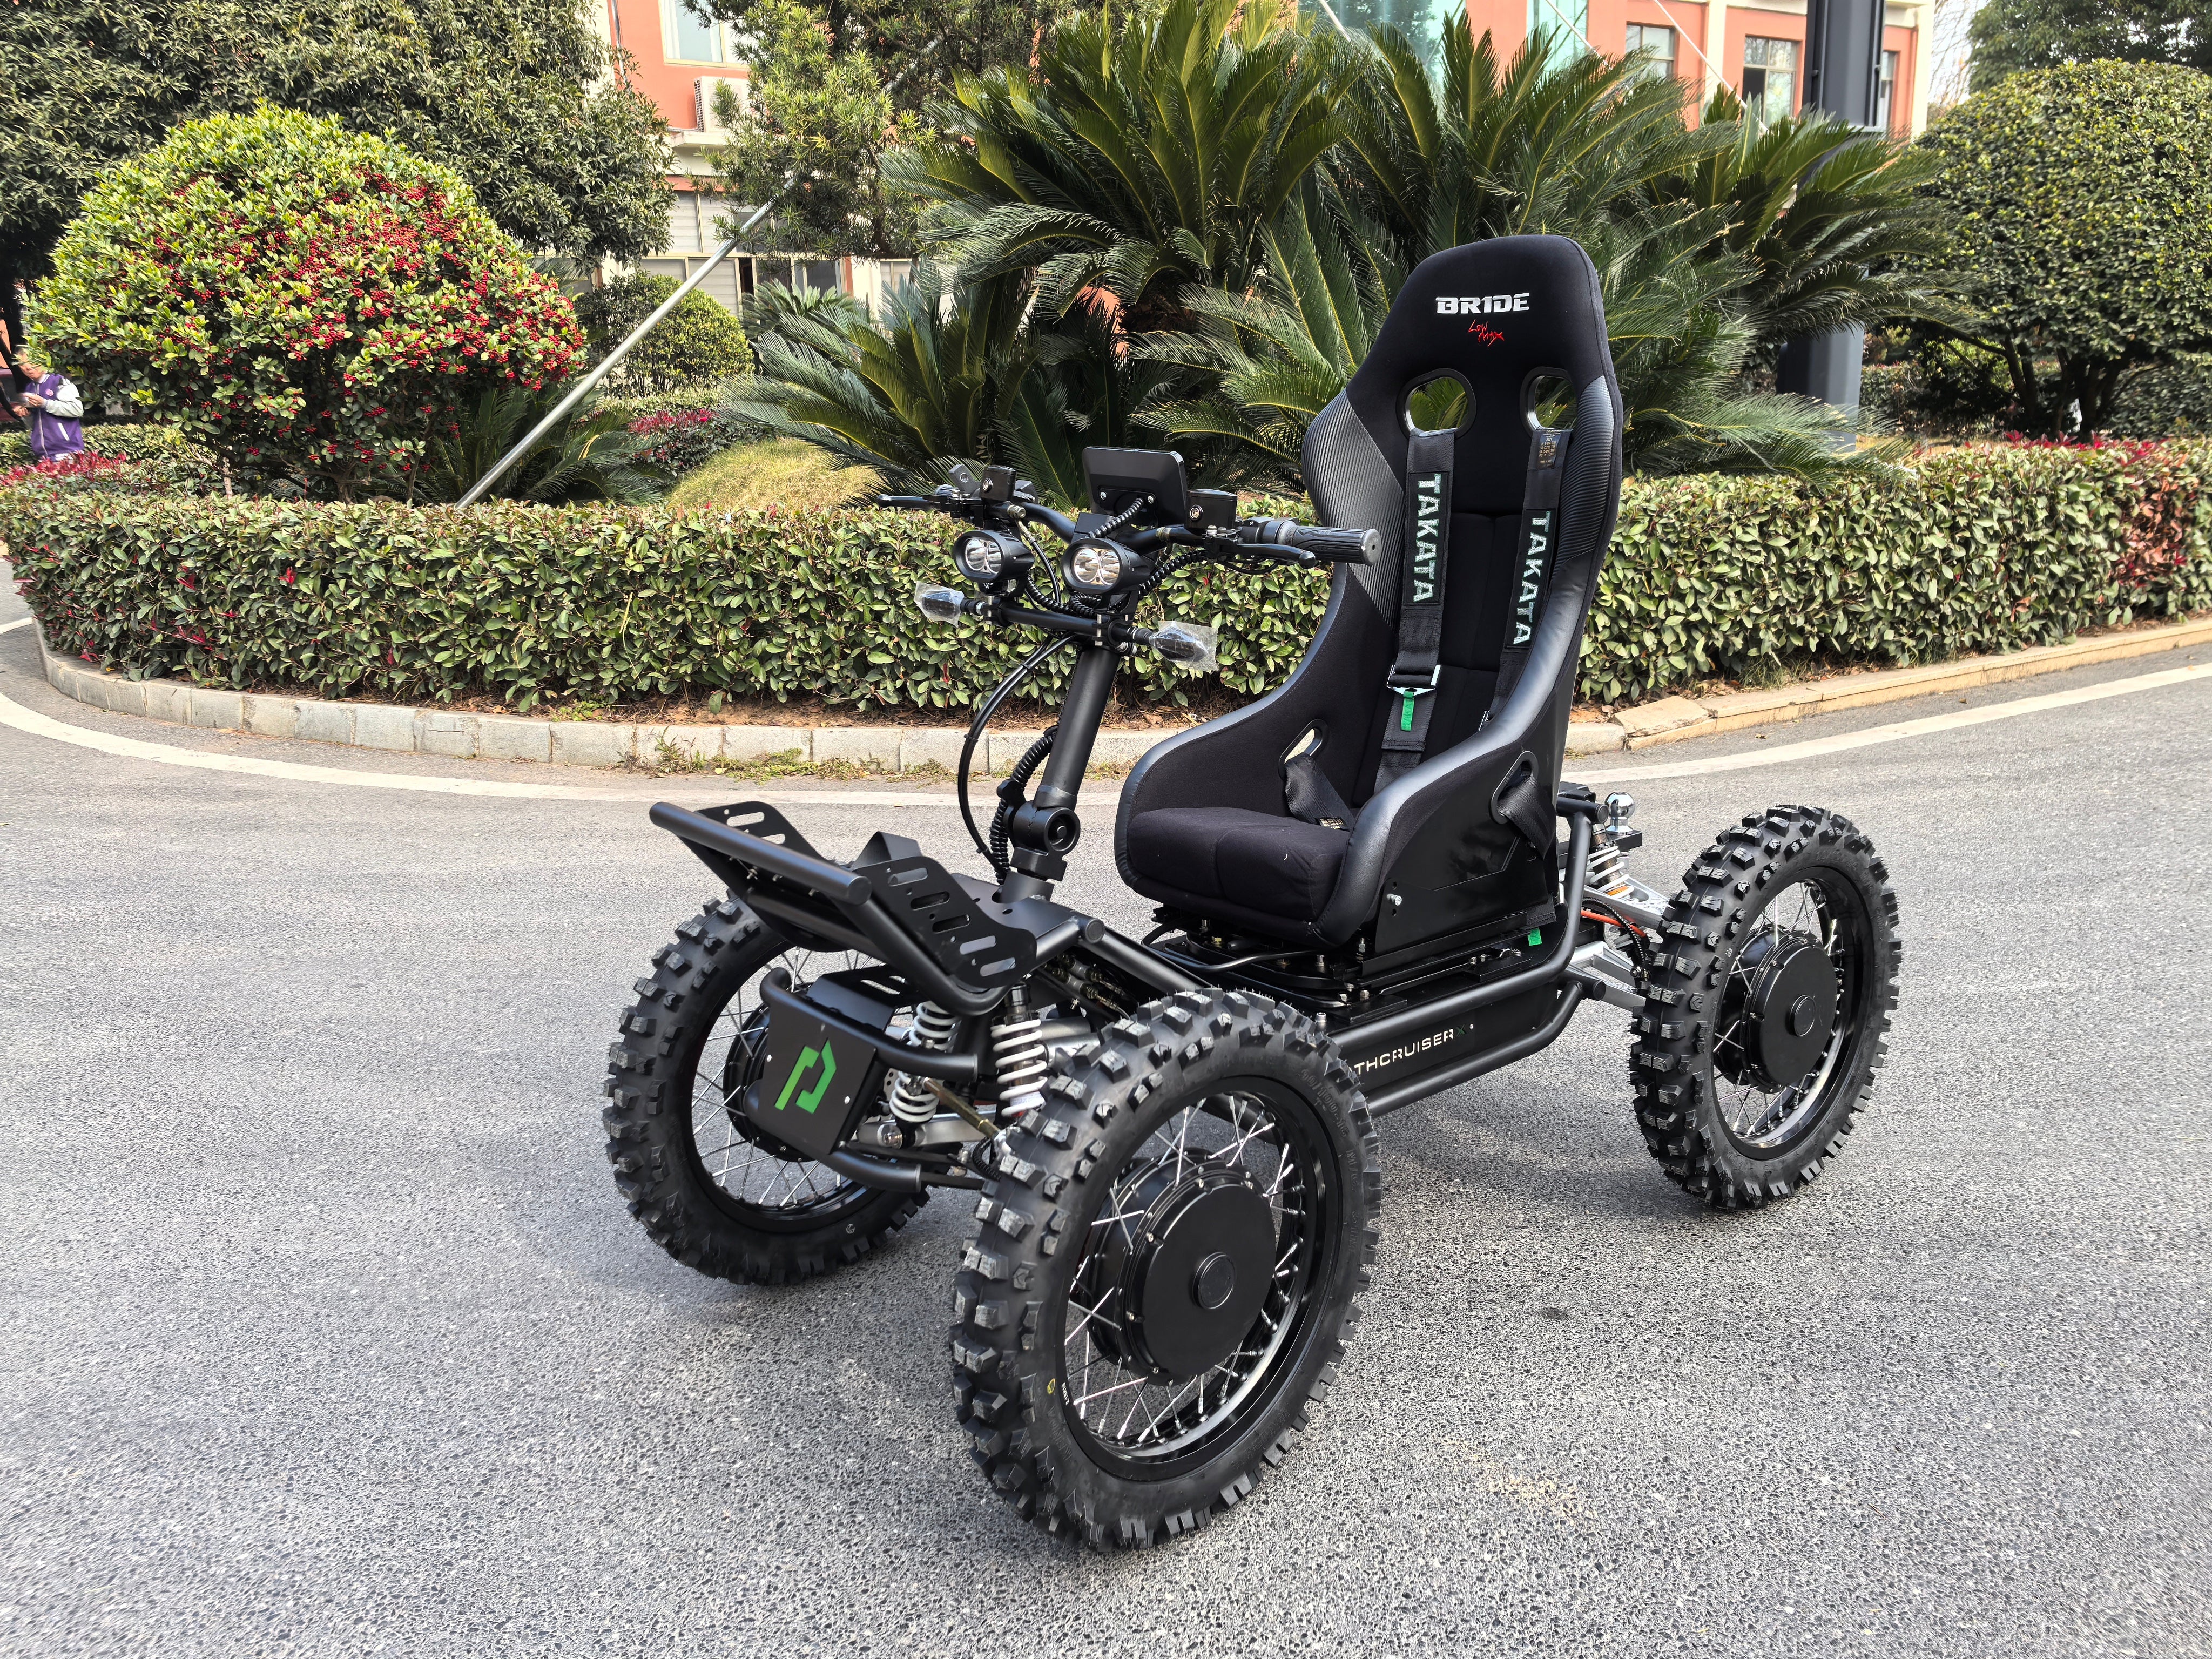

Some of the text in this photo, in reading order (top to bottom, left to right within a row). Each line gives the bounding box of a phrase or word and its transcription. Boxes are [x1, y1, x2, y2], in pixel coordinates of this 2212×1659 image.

[1435, 292, 1530, 314] BRIDE
[1413, 473, 1442, 602] TAKATA
[1513, 511, 1551, 645] TAKATA
[1301, 1068, 1350, 1137] 90/100-16
